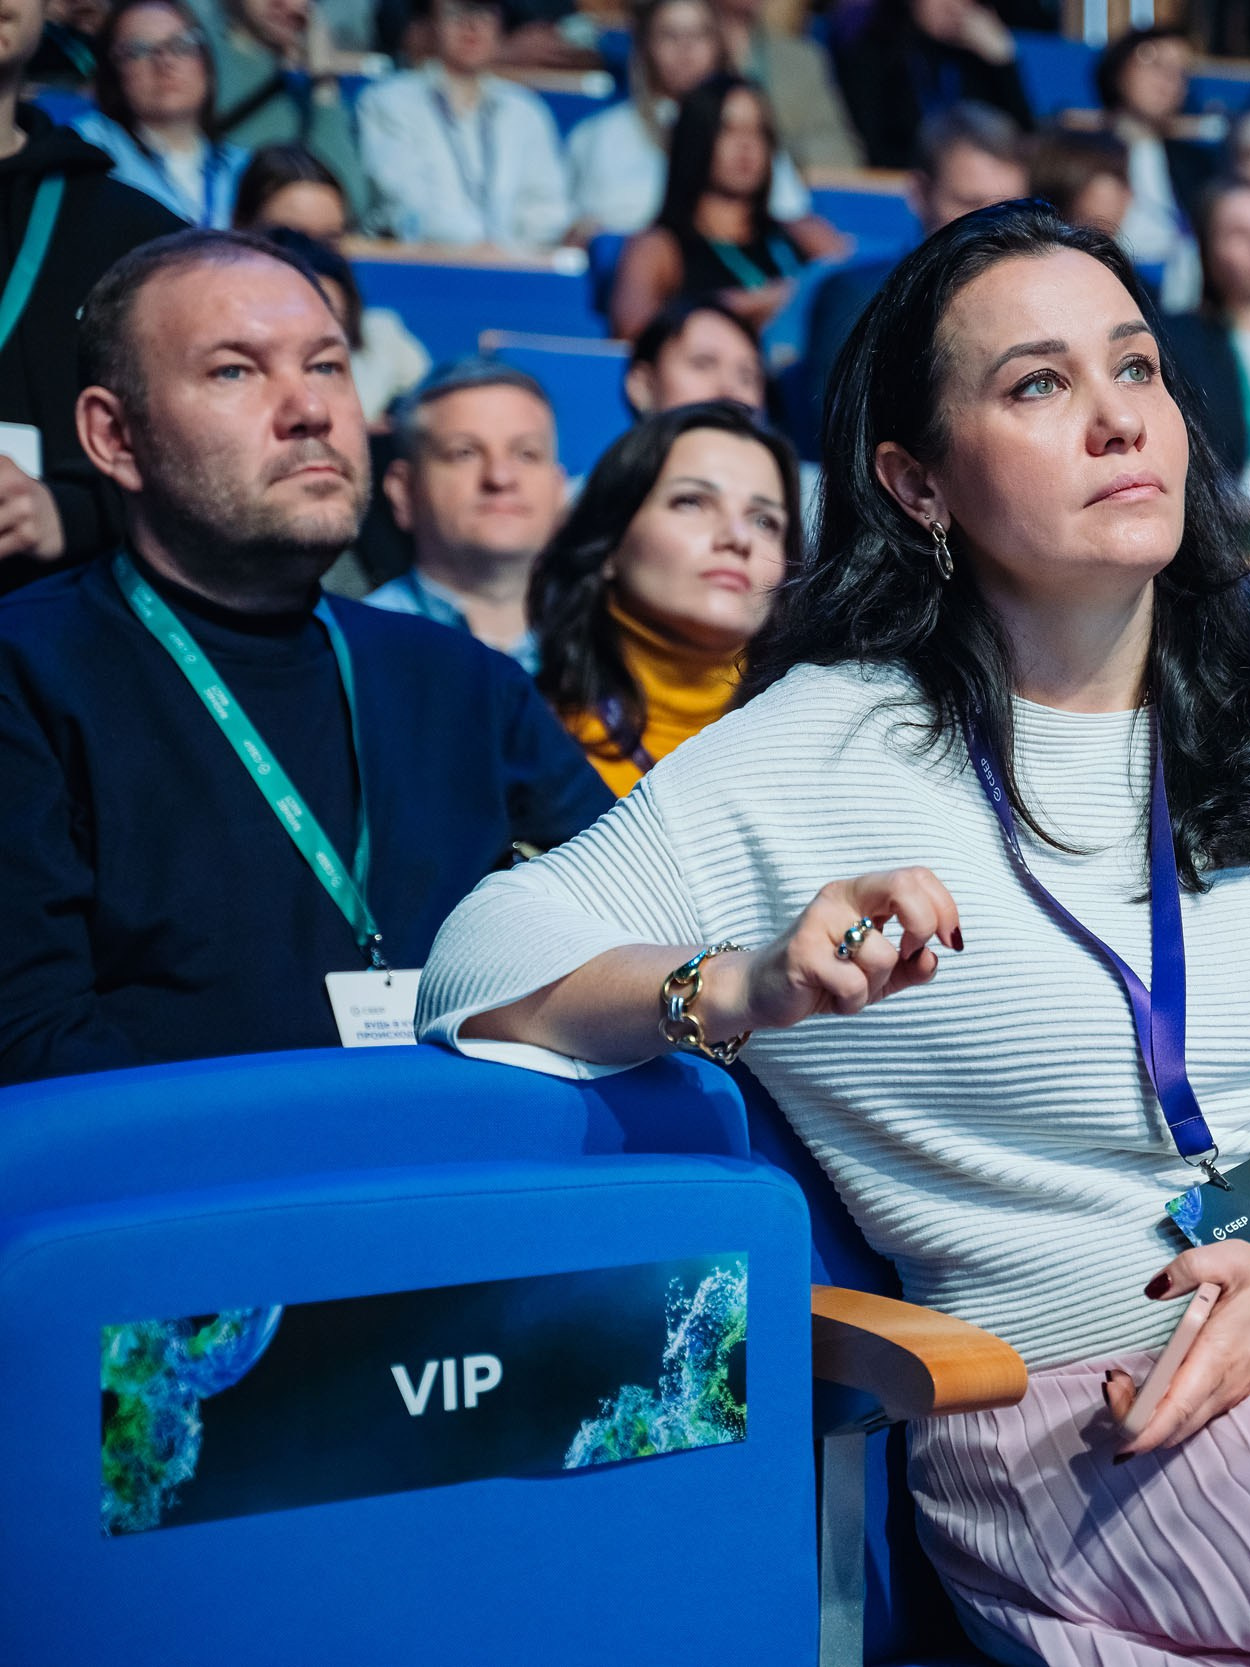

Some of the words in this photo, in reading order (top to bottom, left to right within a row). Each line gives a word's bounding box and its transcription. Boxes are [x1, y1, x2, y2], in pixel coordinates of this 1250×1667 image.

[980, 757, 996, 788] СБЕР
[1225, 1216, 1249, 1233] СБЕР
[390, 1354, 503, 1416] VIP
